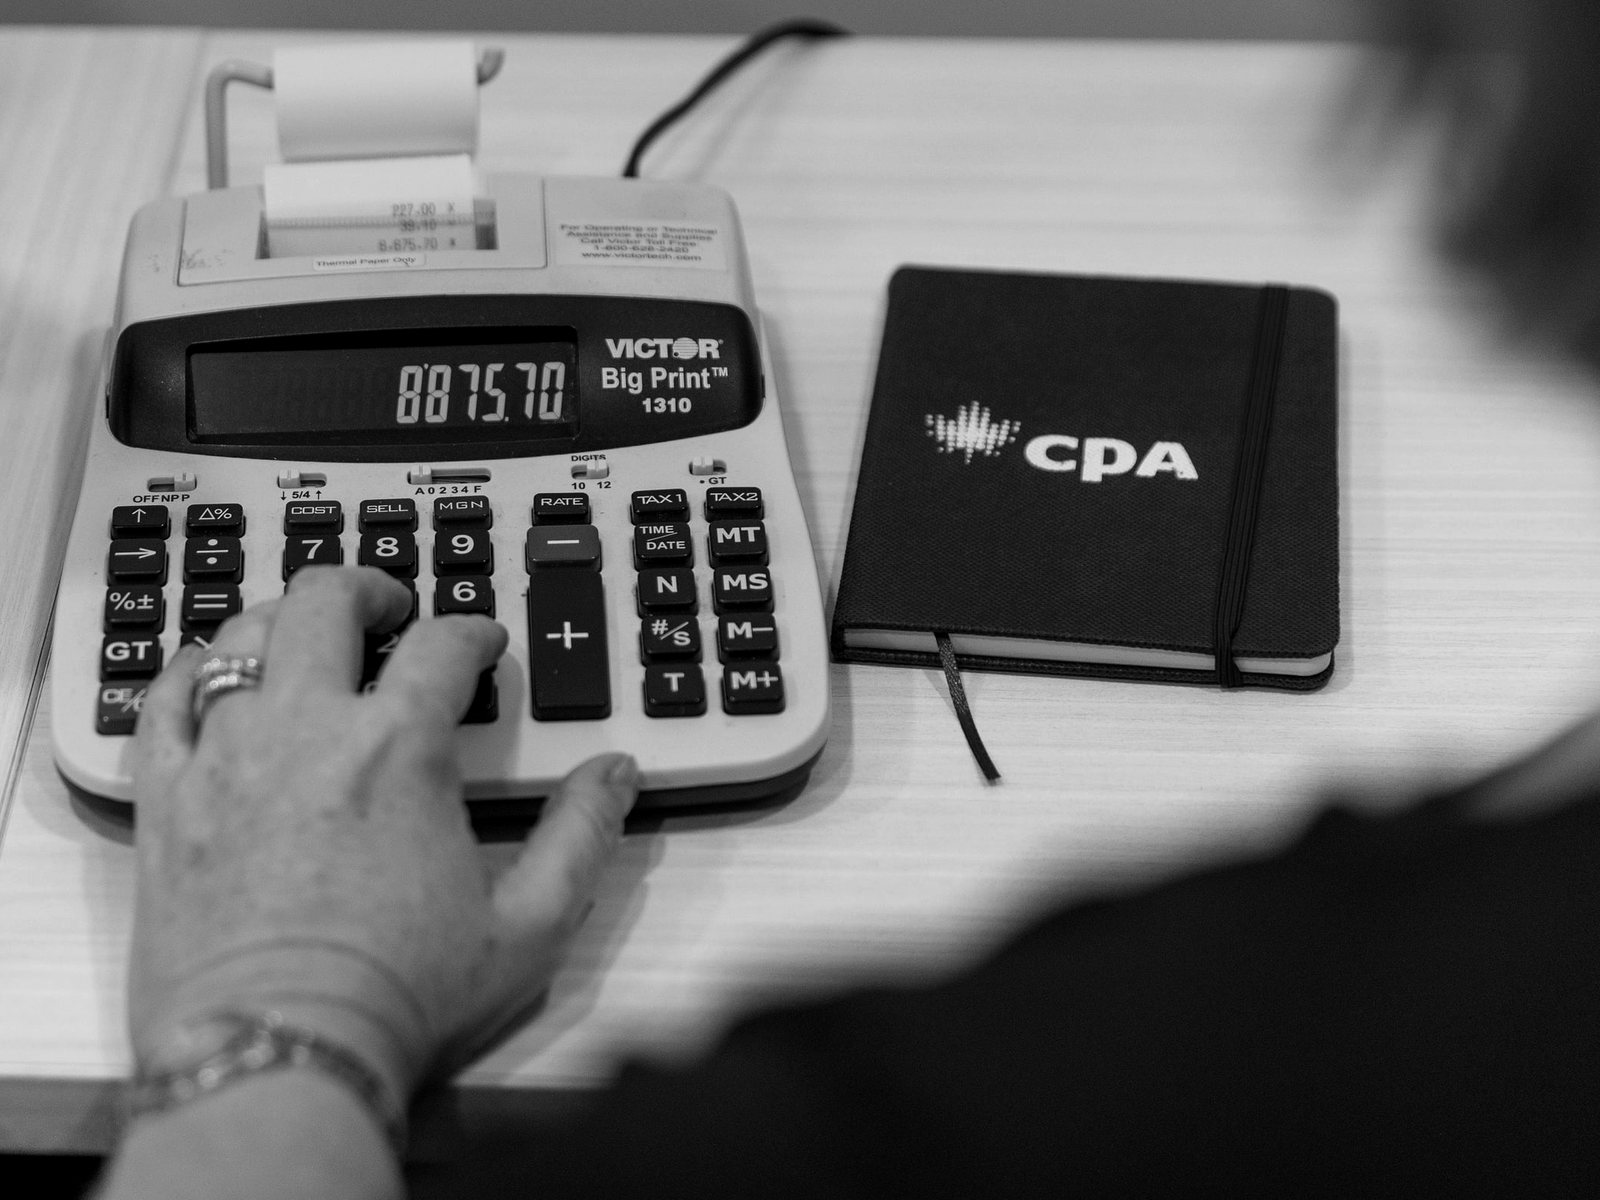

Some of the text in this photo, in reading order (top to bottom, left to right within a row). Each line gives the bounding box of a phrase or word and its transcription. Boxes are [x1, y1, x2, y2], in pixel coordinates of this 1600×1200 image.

[584, 224, 643, 232] Operating
[662, 232, 713, 241] Supplies
[315, 255, 416, 267] Thermal Paper Only
[582, 252, 702, 261] www.victortech.com
[601, 367, 643, 394] Big
[642, 397, 692, 413] 1310
[571, 454, 606, 462] DIGITS
[572, 481, 612, 490] 10 12
[540, 497, 584, 506] RATE
[710, 493, 758, 502] TAX2
[291, 506, 337, 515] COST
[366, 504, 409, 513] SELL
[439, 501, 483, 510] MGN
[716, 527, 760, 543] MT
[301, 540, 323, 559] 7
[375, 537, 400, 556] 8
[451, 534, 475, 554] 9
[646, 541, 686, 550] DATE
[656, 576, 678, 593] N
[722, 573, 768, 590] MS
[452, 581, 477, 602] 6
[105, 641, 153, 661] GT
[663, 672, 685, 692] T
[731, 671, 778, 690] M+
